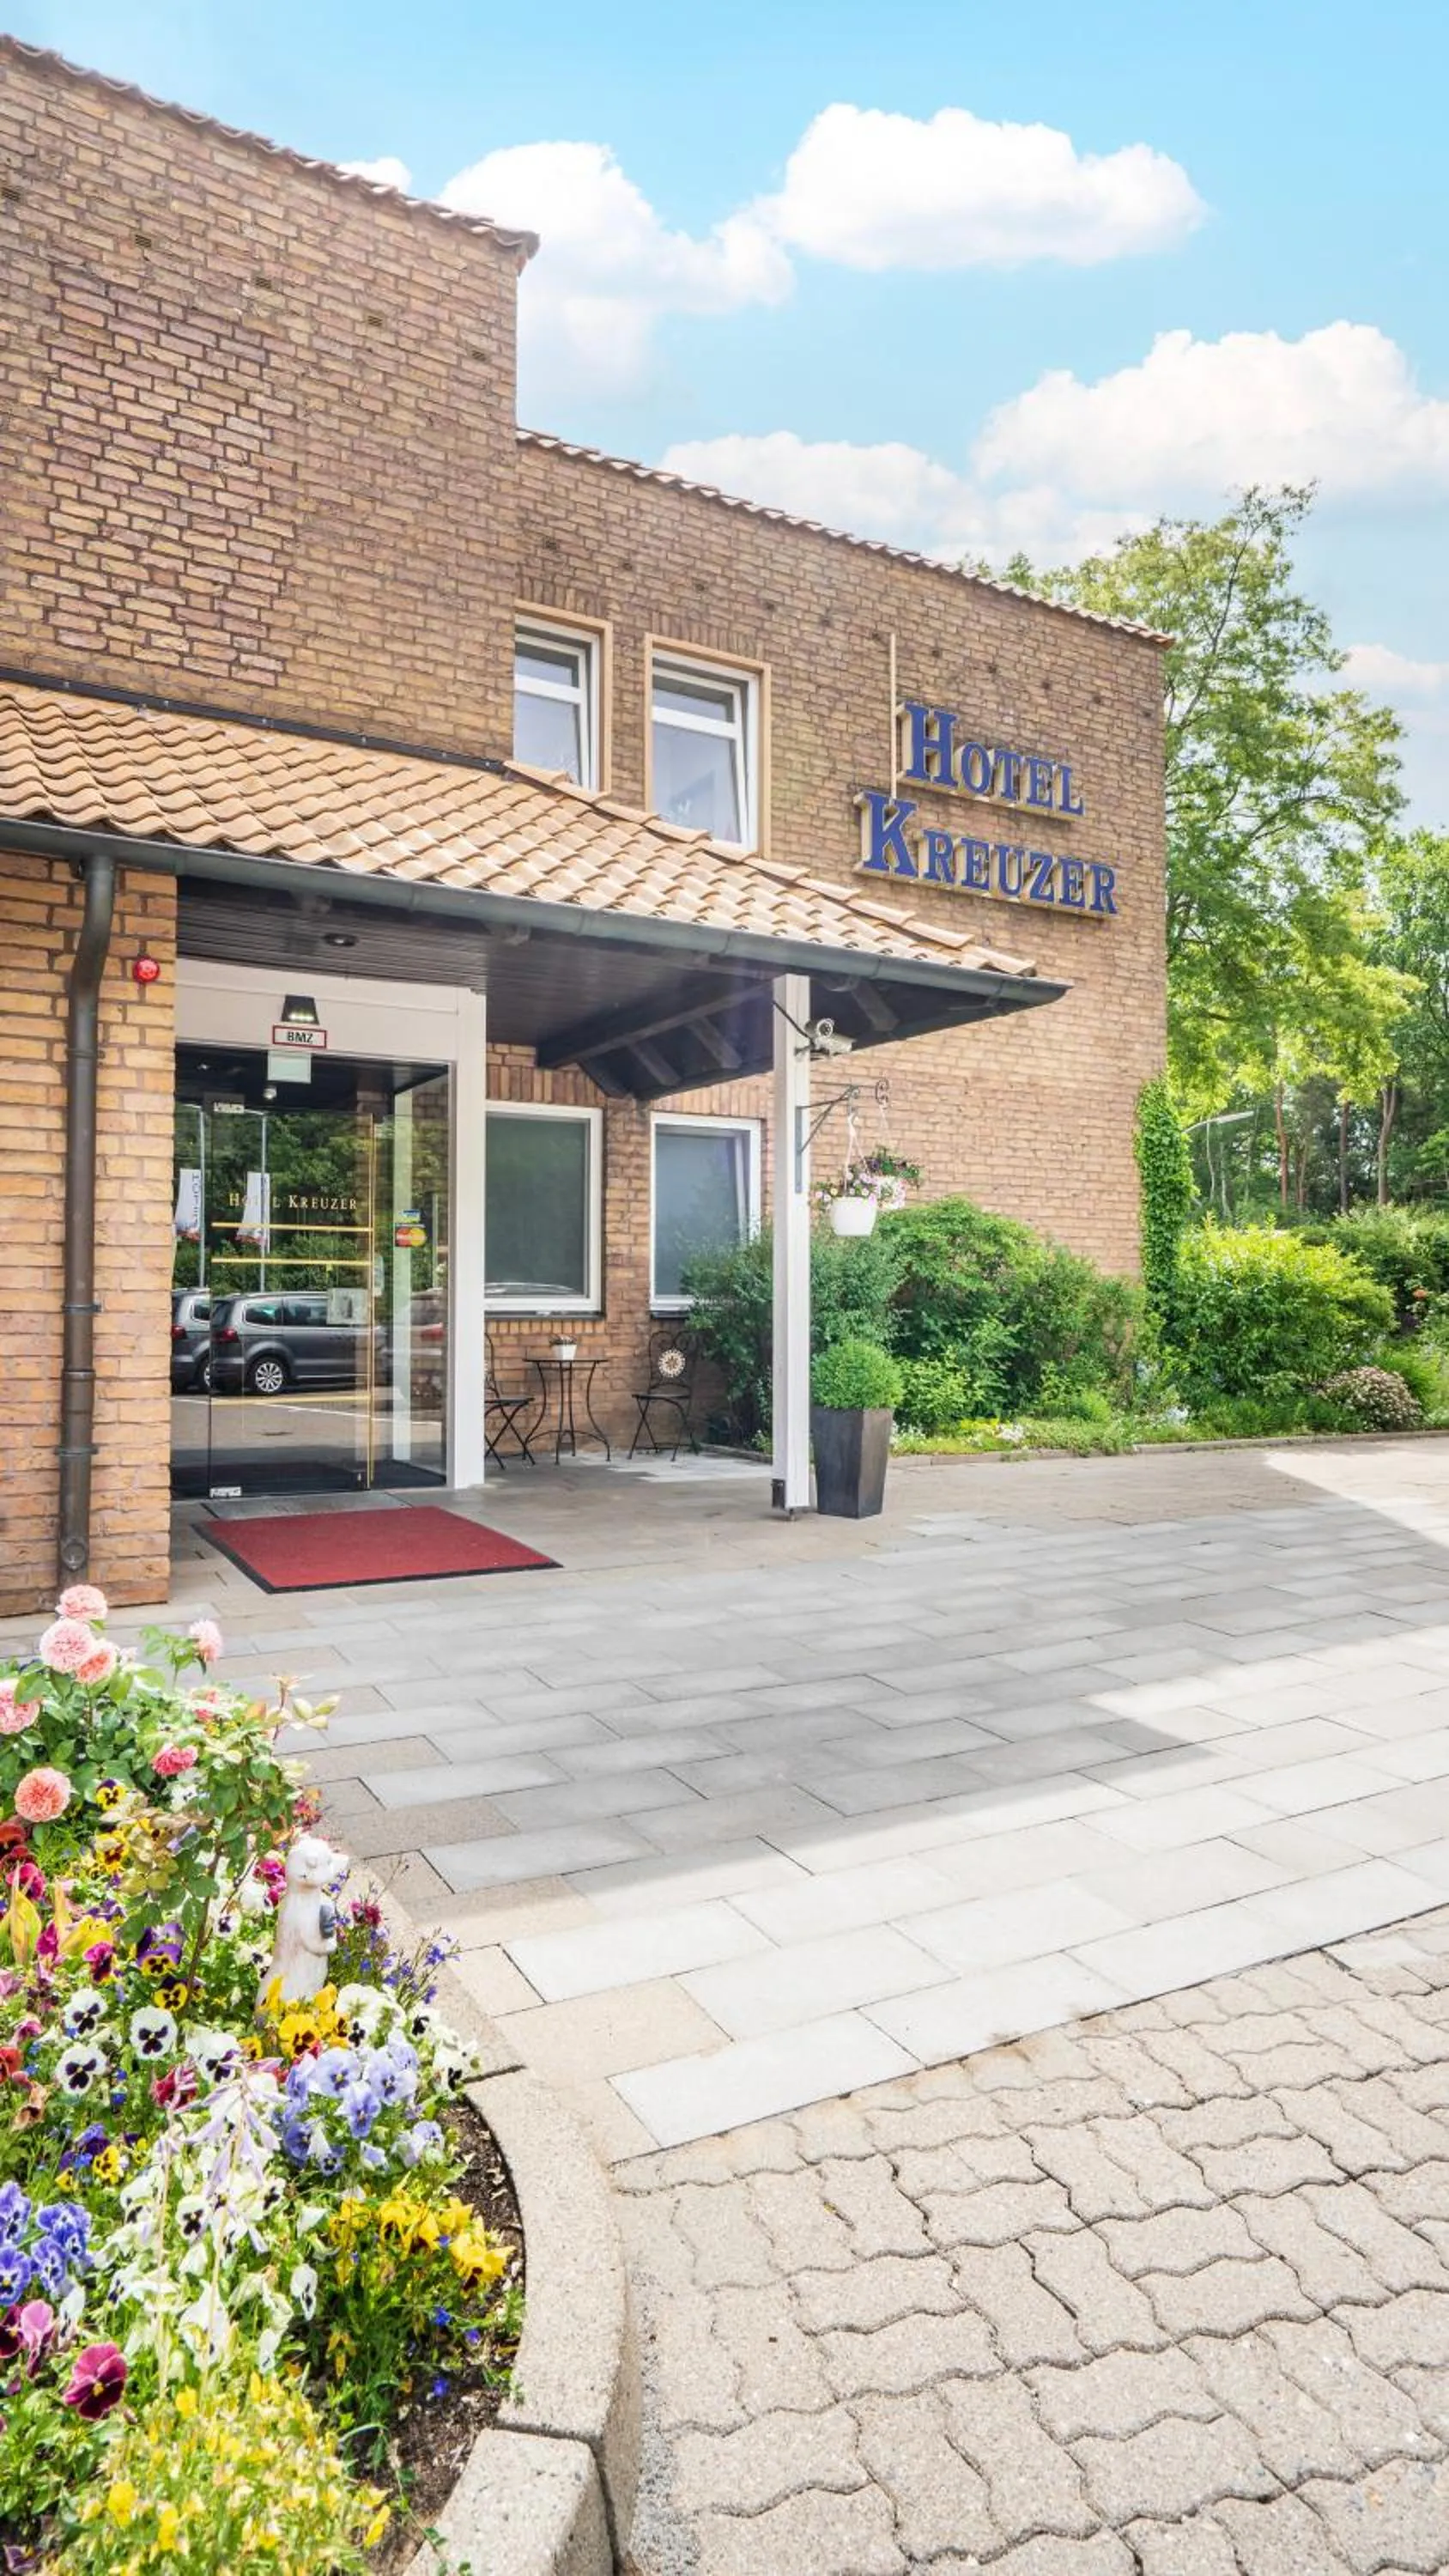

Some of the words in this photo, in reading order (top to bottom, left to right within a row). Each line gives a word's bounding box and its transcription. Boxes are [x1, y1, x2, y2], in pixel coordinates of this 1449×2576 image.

[900, 700, 1084, 816] HOTEL
[858, 790, 1119, 915] KREUZER
[288, 1030, 313, 1044] BMZ
[228, 1192, 282, 1210] HOL
[288, 1194, 358, 1211] KREUZER
